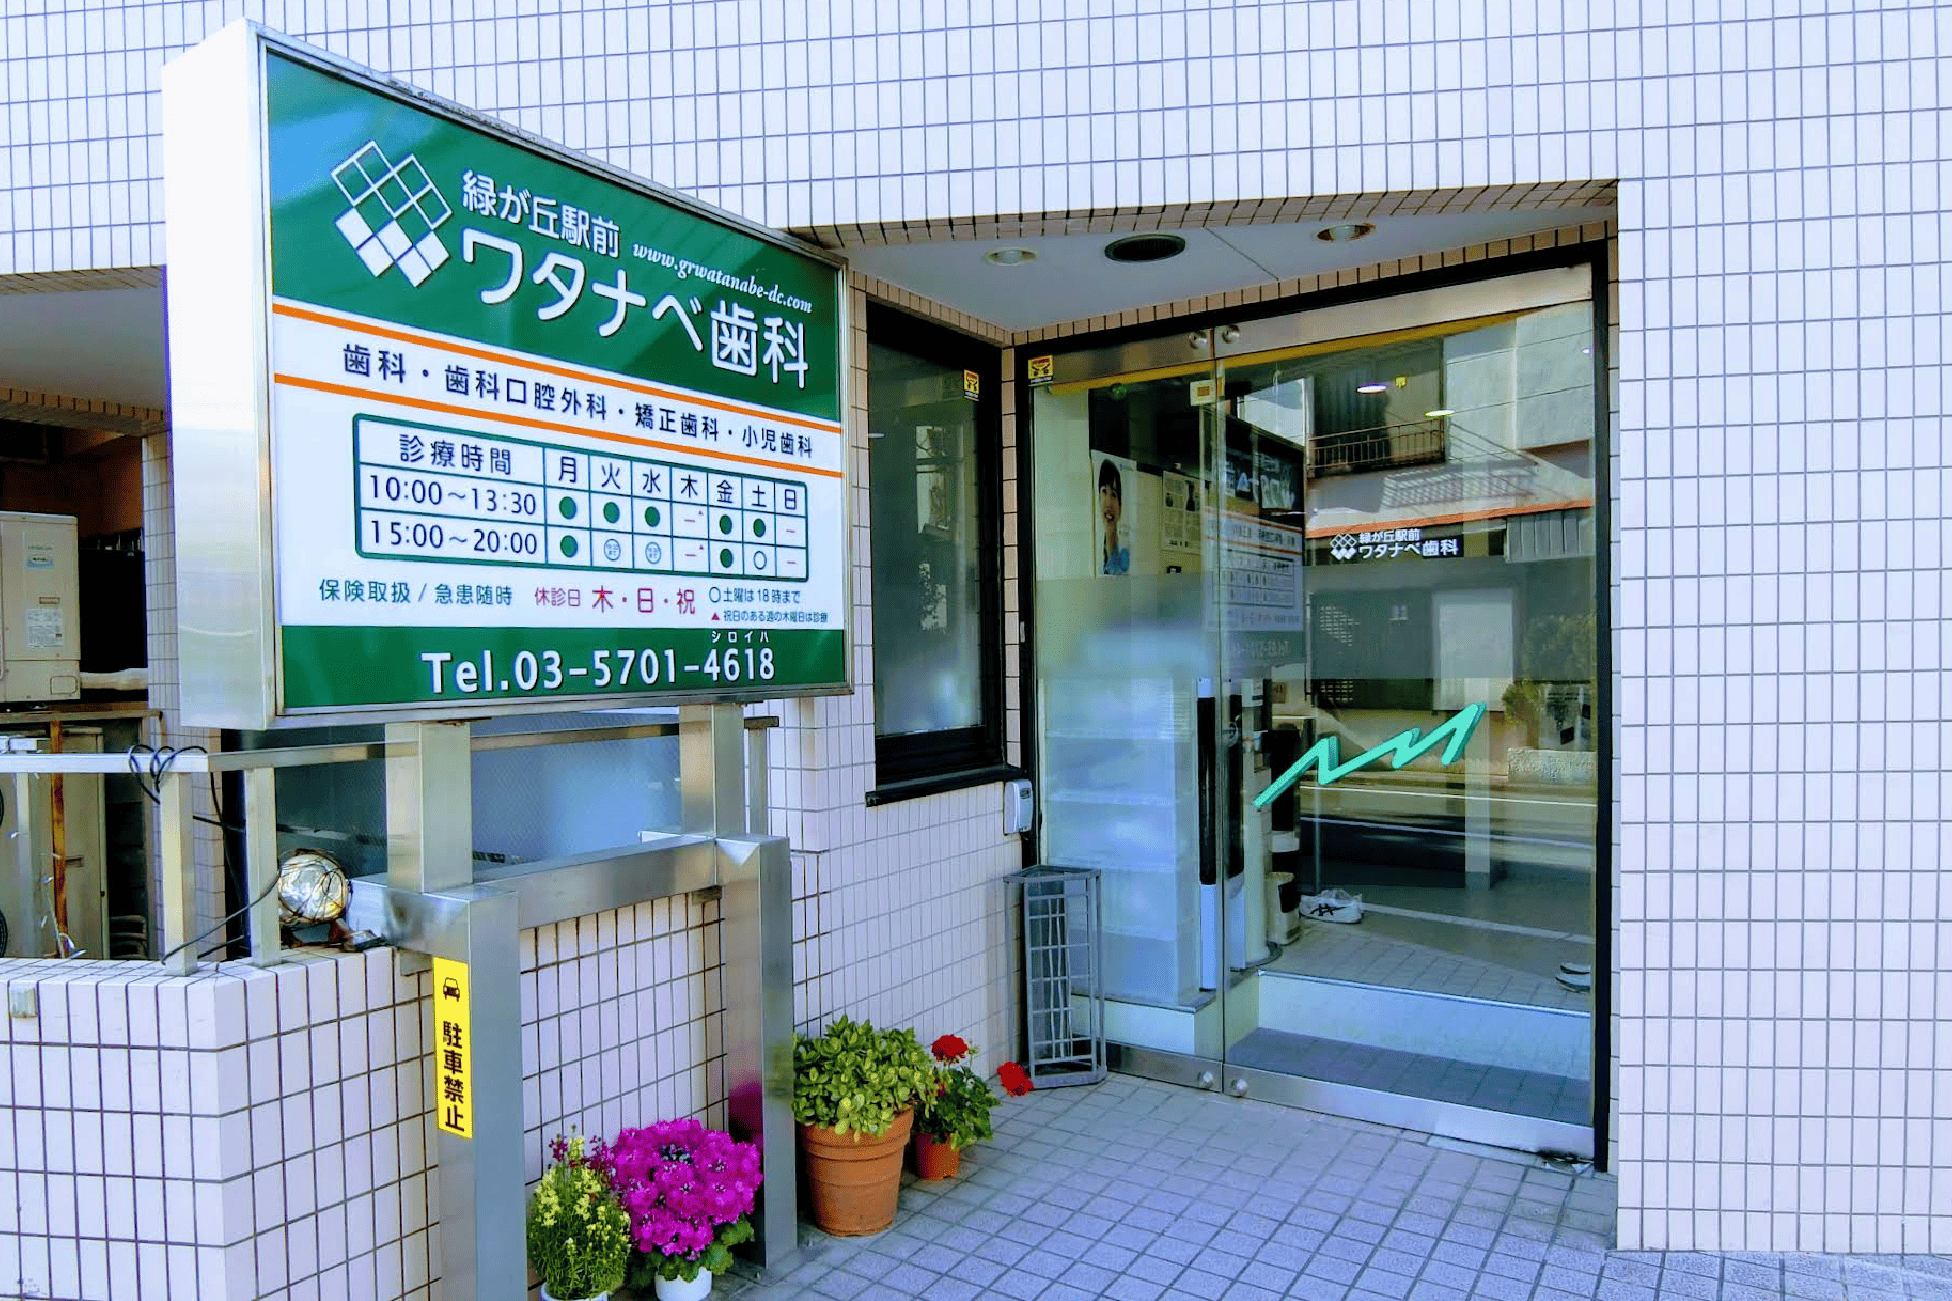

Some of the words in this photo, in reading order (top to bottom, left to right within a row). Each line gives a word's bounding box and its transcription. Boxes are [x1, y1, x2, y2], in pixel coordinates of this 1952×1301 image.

[463, 169, 620, 259] 緑が丘駅前
[462, 227, 810, 388] ワタナベ歯科
[632, 243, 813, 314] www.grwatanabe-dc.com
[399, 433, 511, 476] 診療時間
[558, 455, 577, 483] 月
[601, 462, 621, 490] 火
[642, 469, 661, 494] 水
[680, 474, 698, 498] 木
[716, 479, 733, 504] 金
[751, 485, 767, 508] 土
[784, 488, 798, 510] 日
[1359, 528, 1421, 544] 緑が丘駅前
[1359, 538, 1459, 559] ワタナベ歯科
[534, 586, 581, 607] 休診日
[711, 630, 770, 644] シロイハ
[442, 1020, 465, 1132] 駐車禁止
